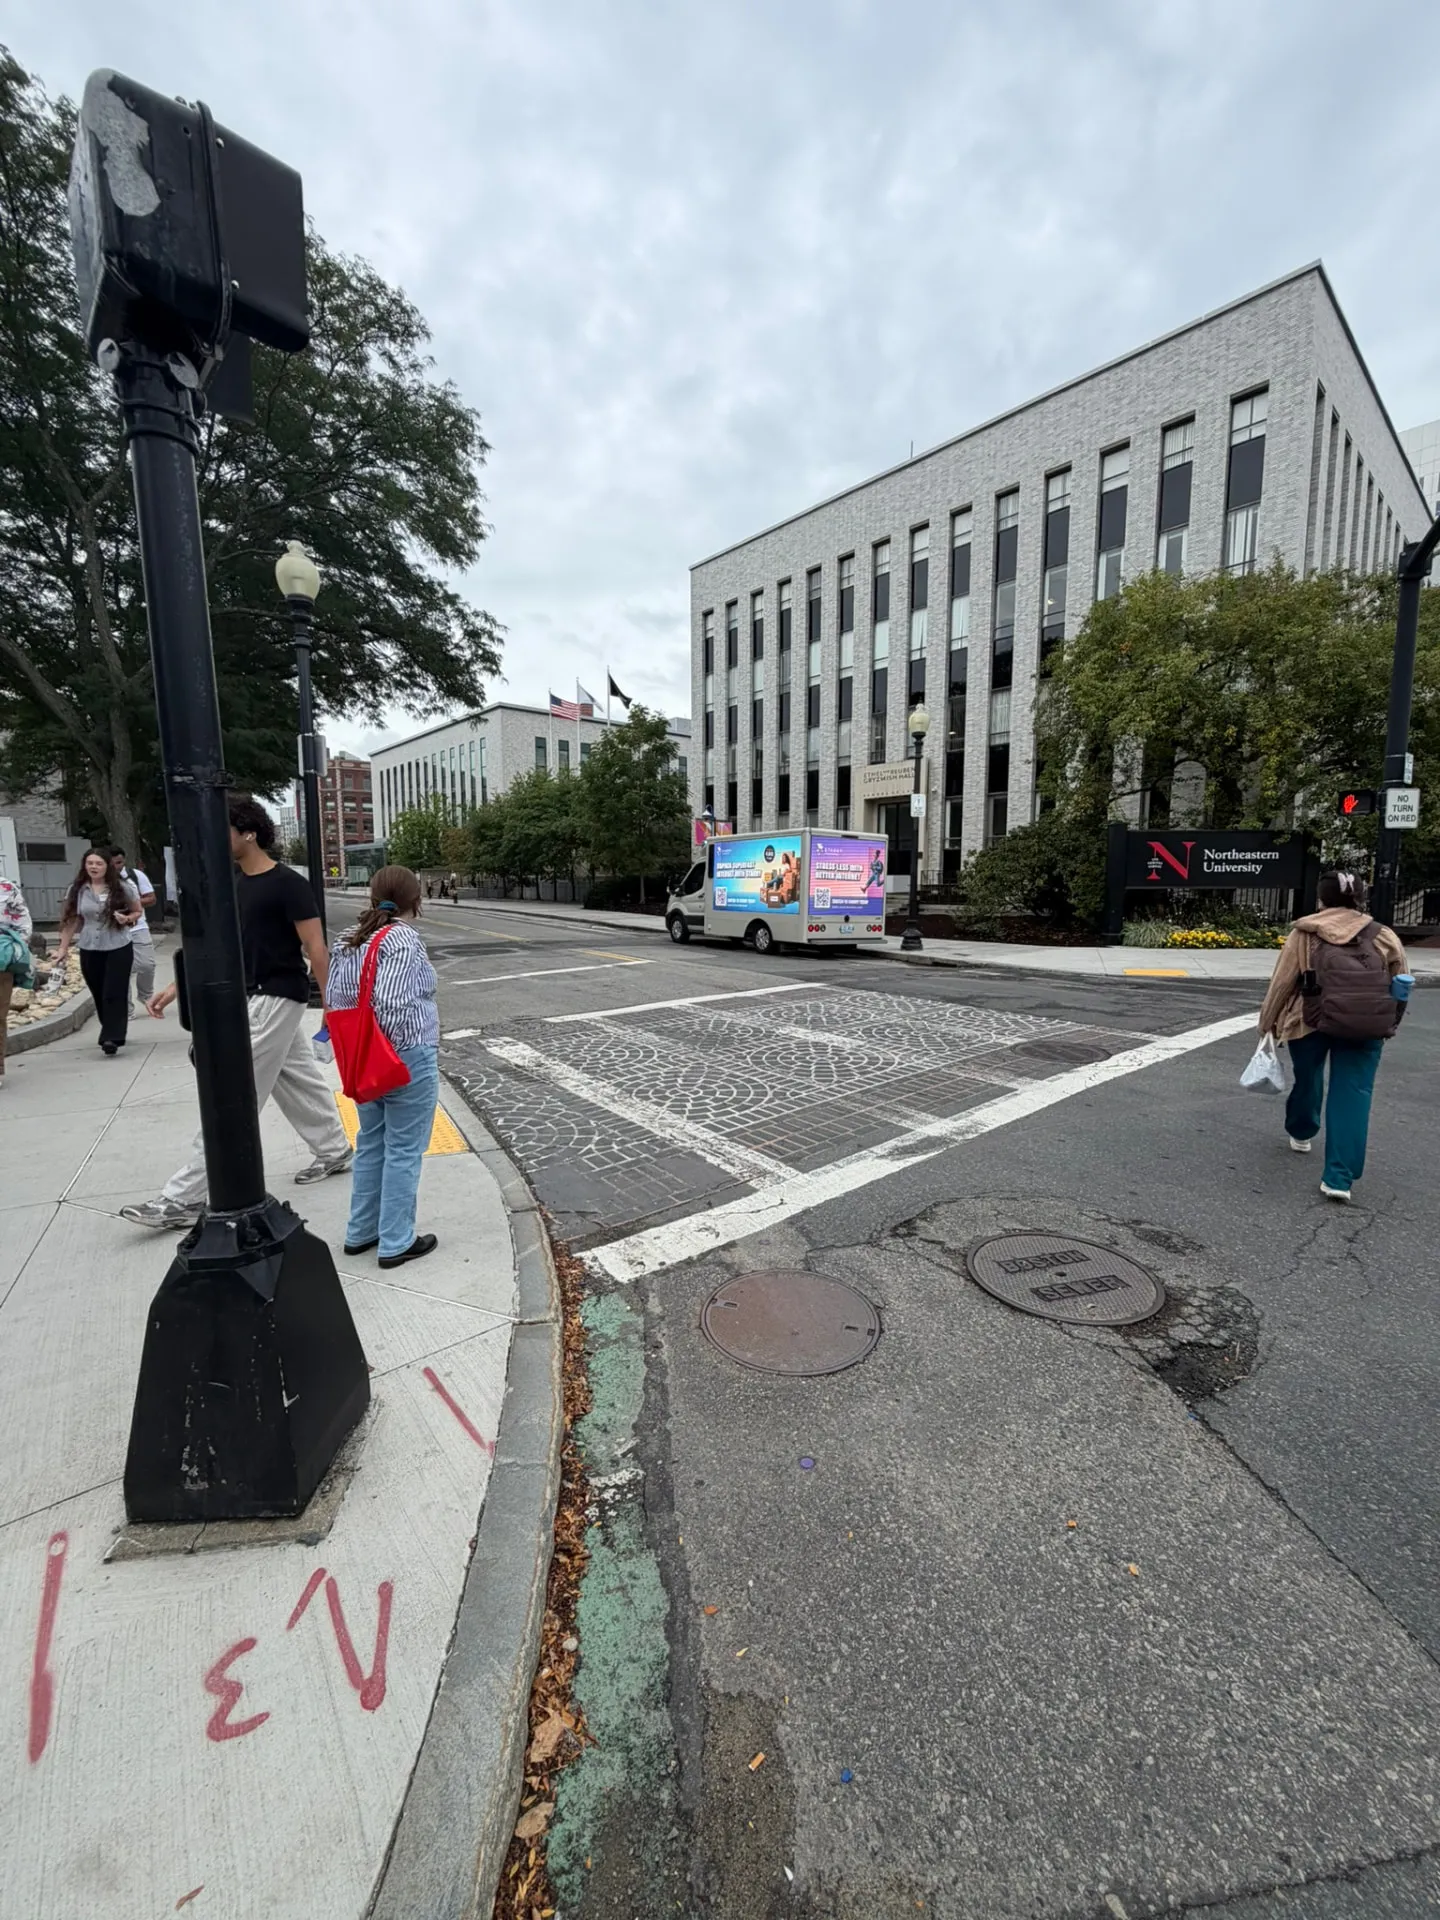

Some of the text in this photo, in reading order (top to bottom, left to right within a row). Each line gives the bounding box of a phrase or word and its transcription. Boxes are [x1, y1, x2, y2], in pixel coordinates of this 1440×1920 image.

[1397, 795, 1409, 803] NO
[1392, 804, 1413, 812] TURN
[1387, 814, 1417, 822] ON RED
[1146, 841, 1197, 880] N
[1203, 848, 1280, 860] Northeastern
[1203, 861, 1263, 875] University
[1000, 1250, 1089, 1273] BOSTON
[1035, 1275, 1128, 1301] SEWER
